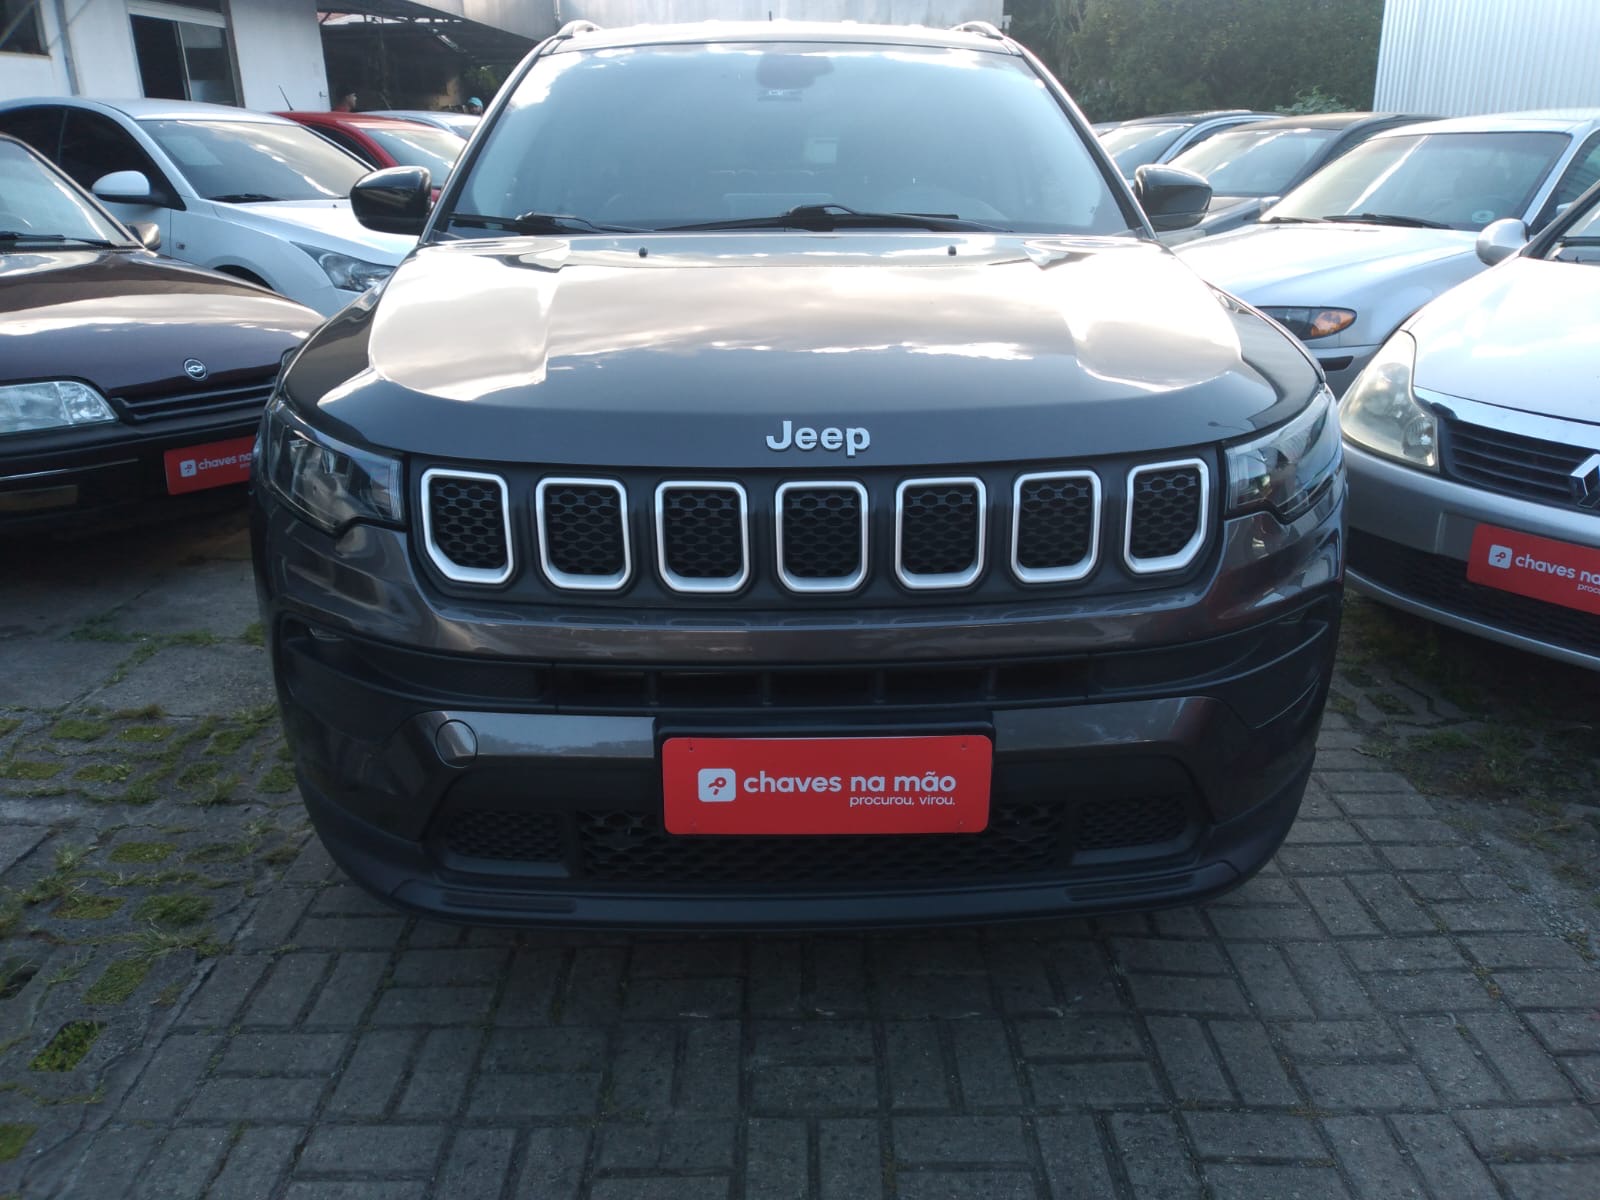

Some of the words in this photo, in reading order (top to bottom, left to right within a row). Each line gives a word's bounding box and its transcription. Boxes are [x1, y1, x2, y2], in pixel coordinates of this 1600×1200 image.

[766, 420, 871, 456] Jeep
[198, 455, 237, 470] chaves
[1515, 553, 1576, 579] chaves
[743, 771, 842, 793] chaves
[850, 774, 885, 792] na
[893, 771, 957, 792] mão
[919, 795, 955, 806] virou.
